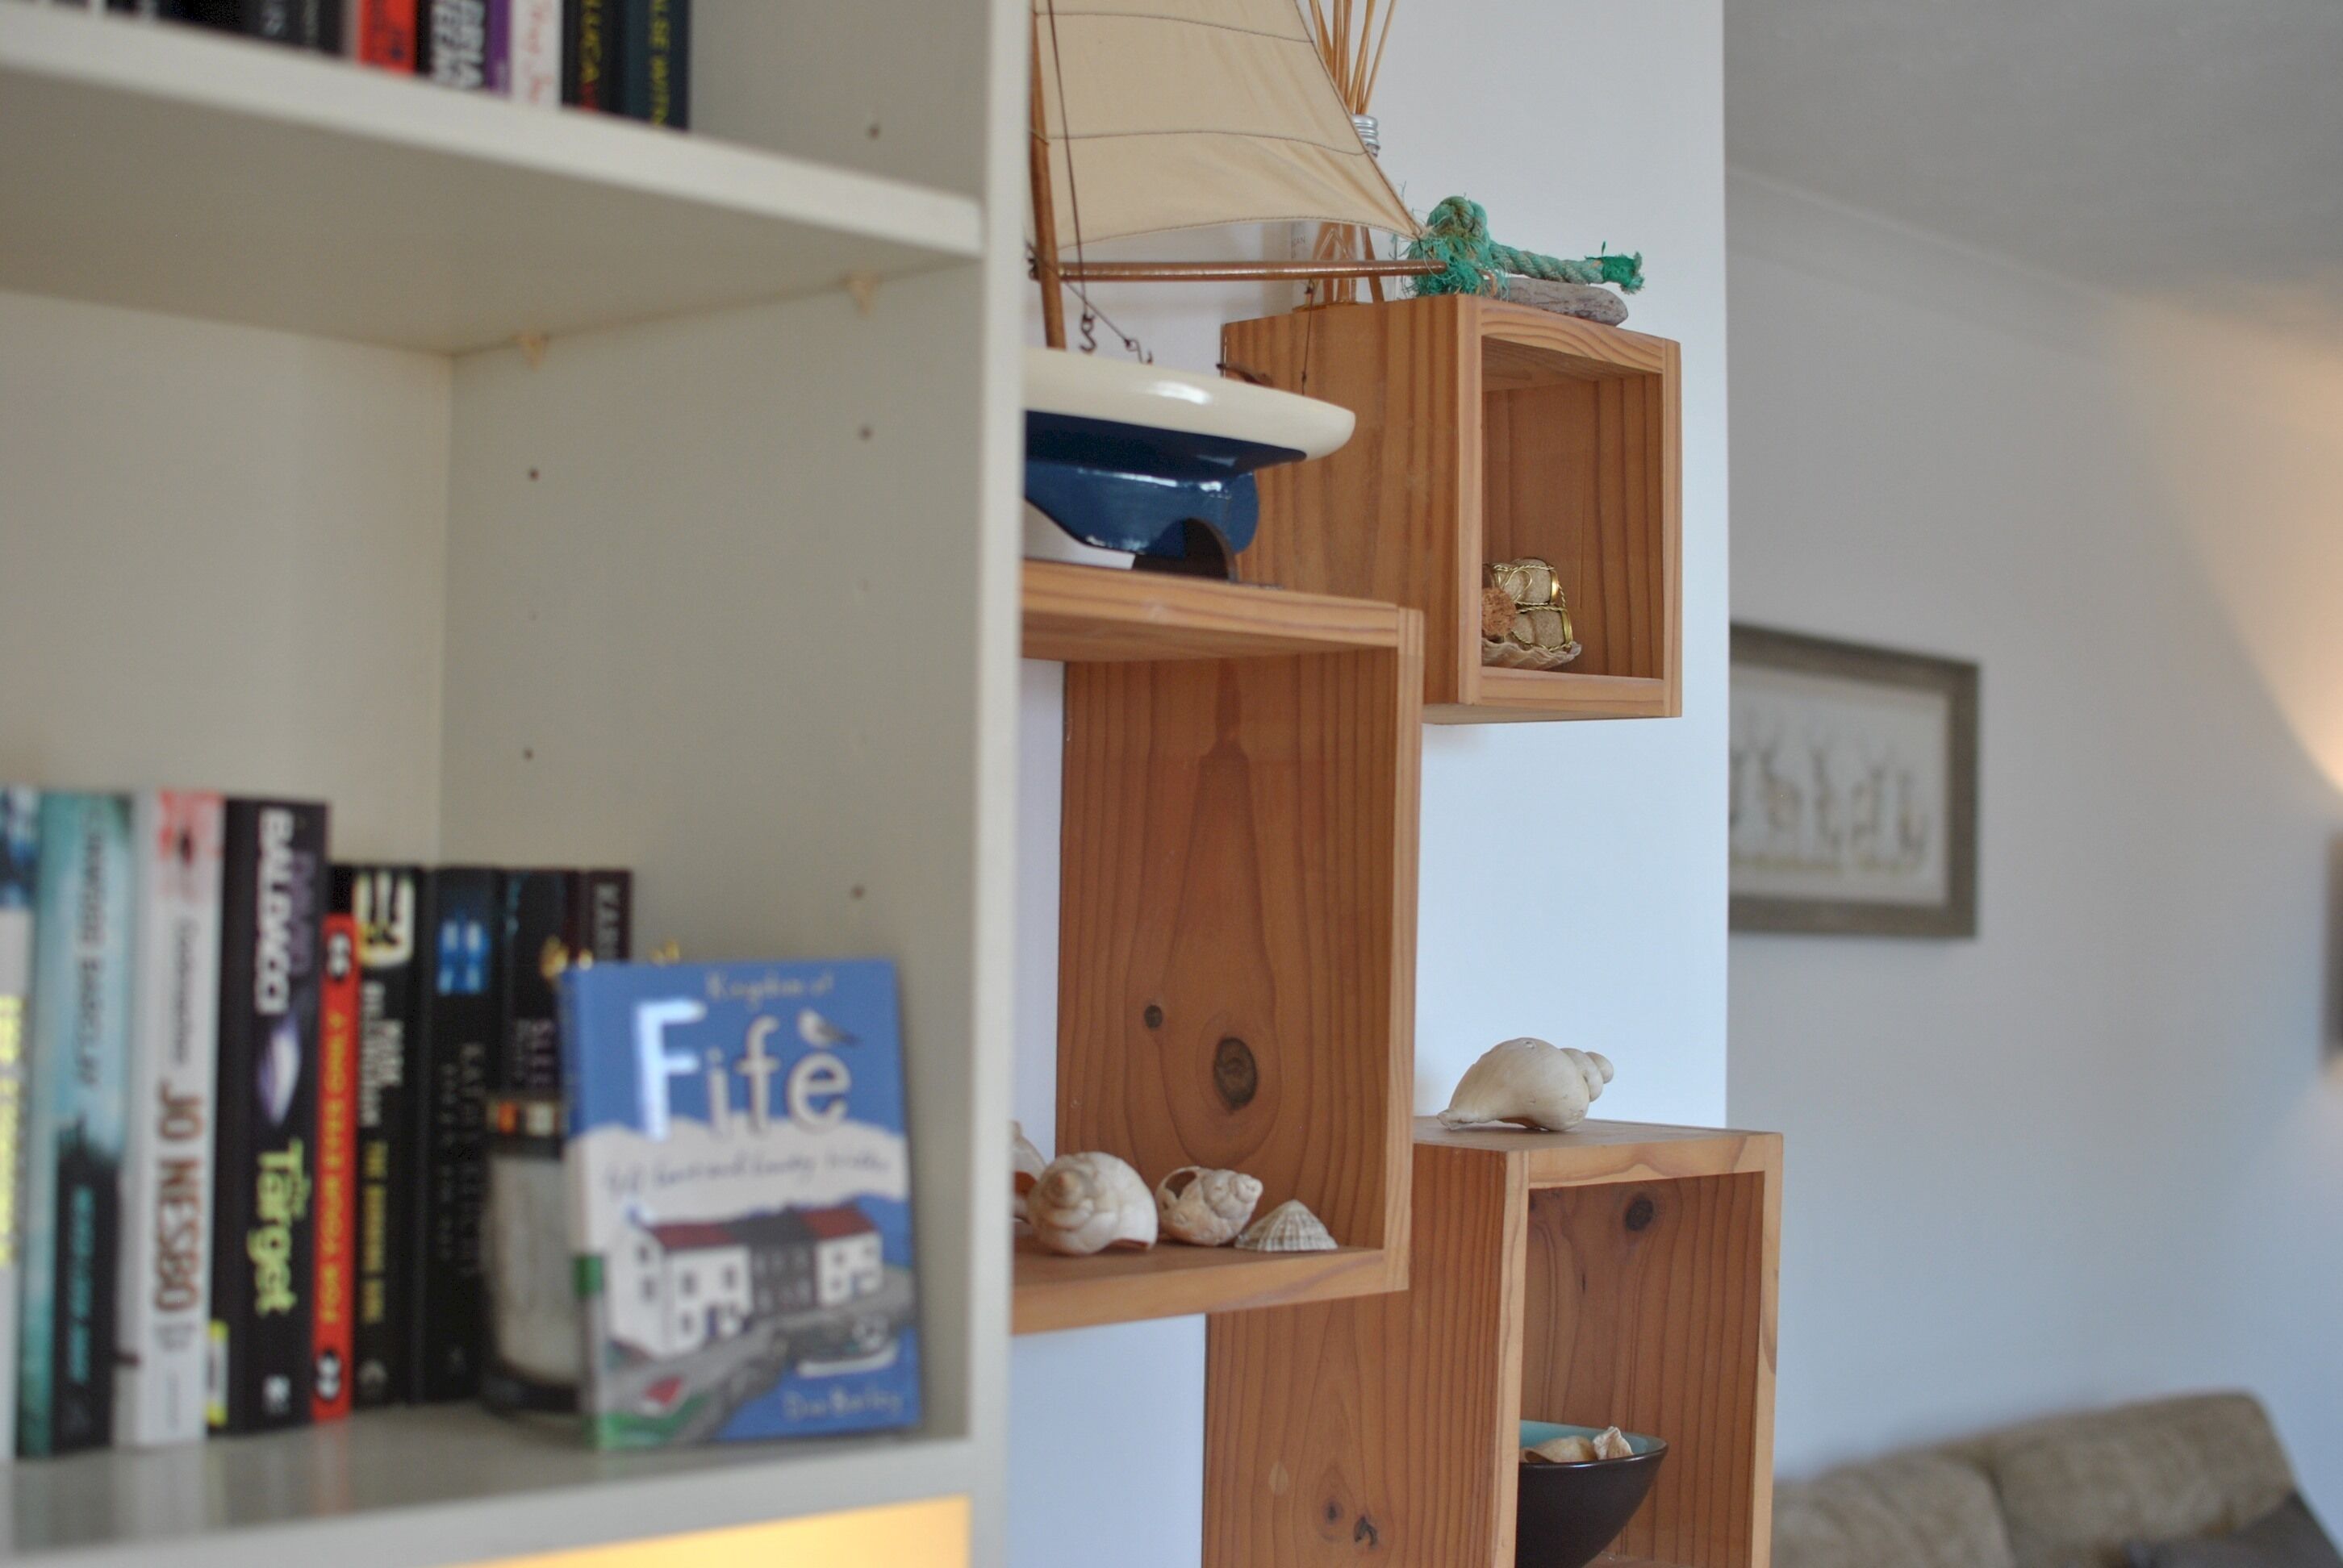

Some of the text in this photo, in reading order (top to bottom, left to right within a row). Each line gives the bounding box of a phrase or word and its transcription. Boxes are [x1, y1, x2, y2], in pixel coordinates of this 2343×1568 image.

[254, 808, 294, 1015] BALDACCI
[159, 1078, 205, 1142] JO
[634, 996, 852, 1143] Fife
[246, 1136, 305, 1320] Target
[320, 1011, 348, 1323] FOR YOUR EYES ONLY
